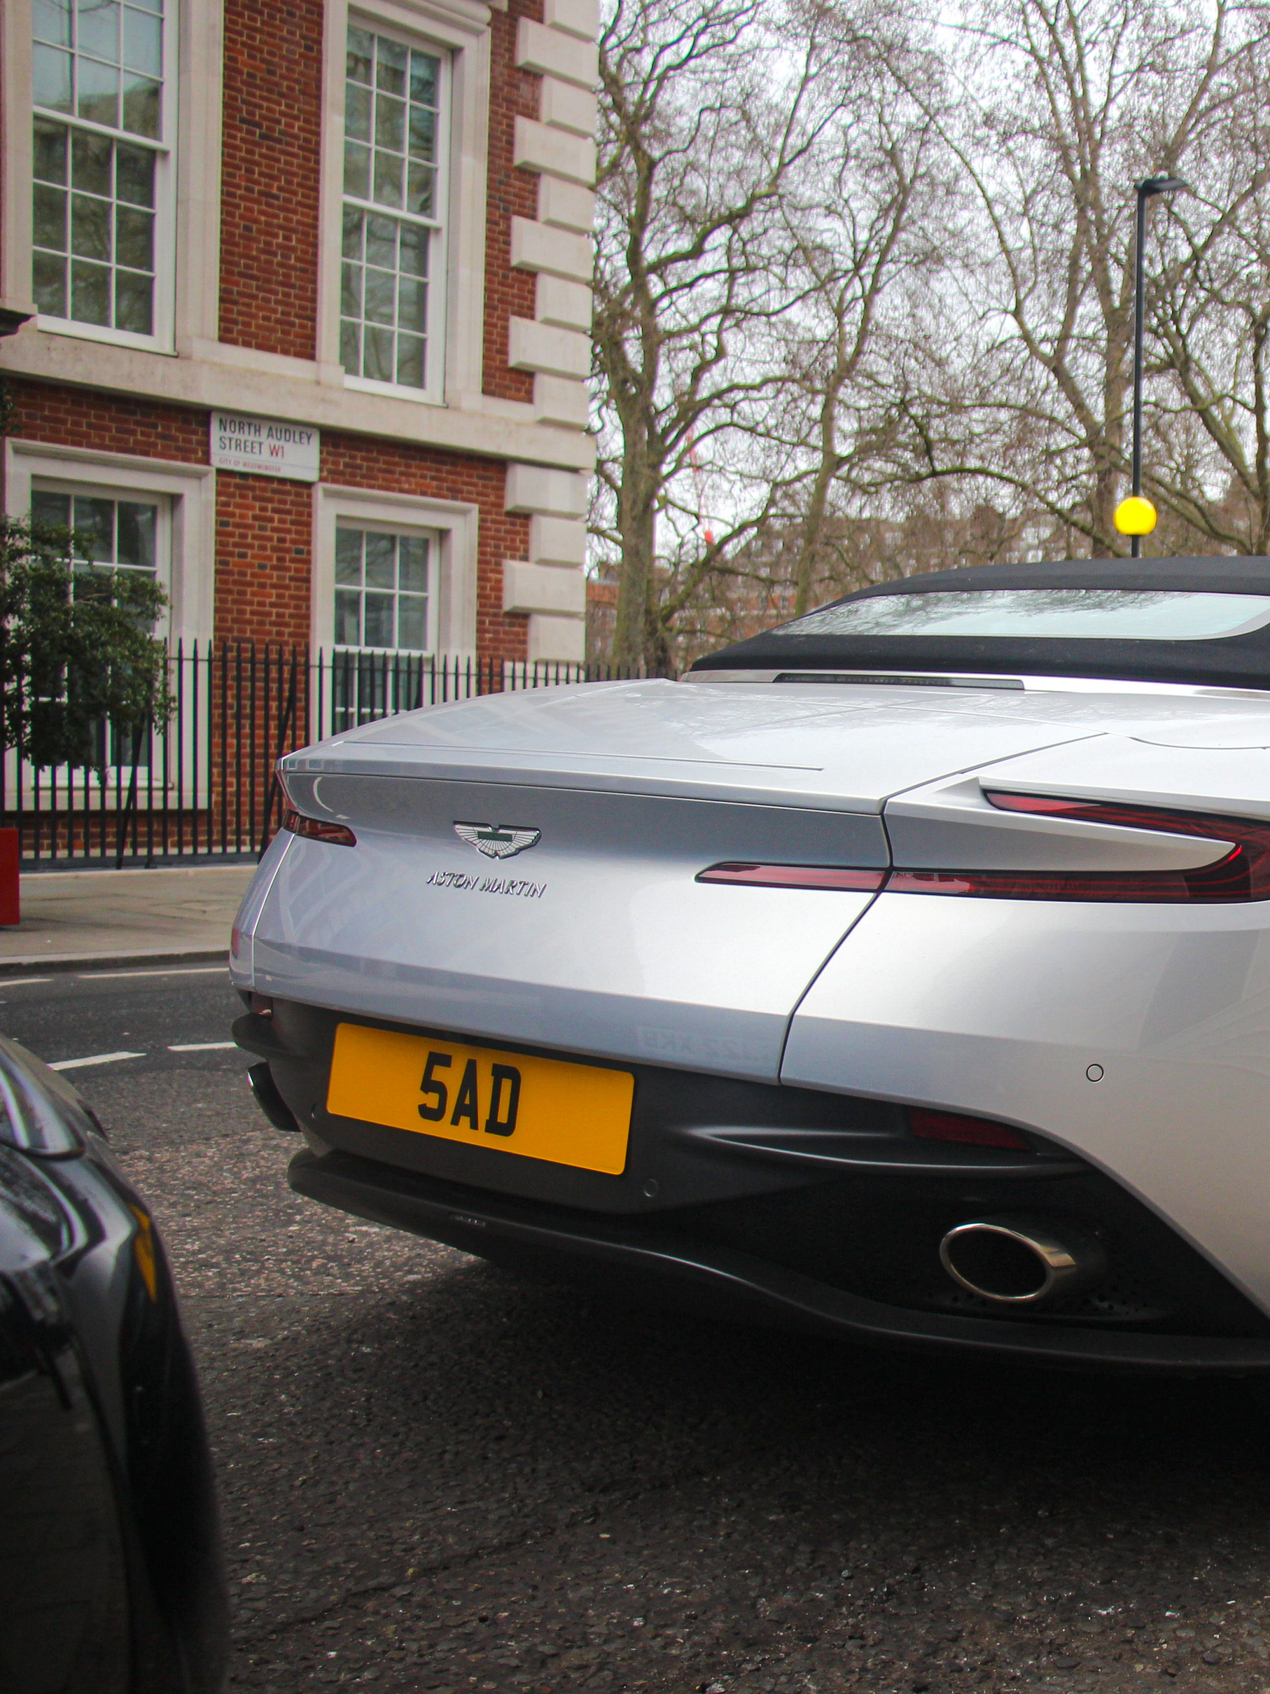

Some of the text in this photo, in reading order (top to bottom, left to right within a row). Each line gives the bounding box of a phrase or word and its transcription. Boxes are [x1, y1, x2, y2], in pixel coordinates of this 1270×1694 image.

[219, 418, 313, 446] NORTH AUDLEY
[219, 436, 285, 458] STREET W1
[426, 870, 547, 898] ASTON MARTIN
[417, 1050, 522, 1138] 5AD
